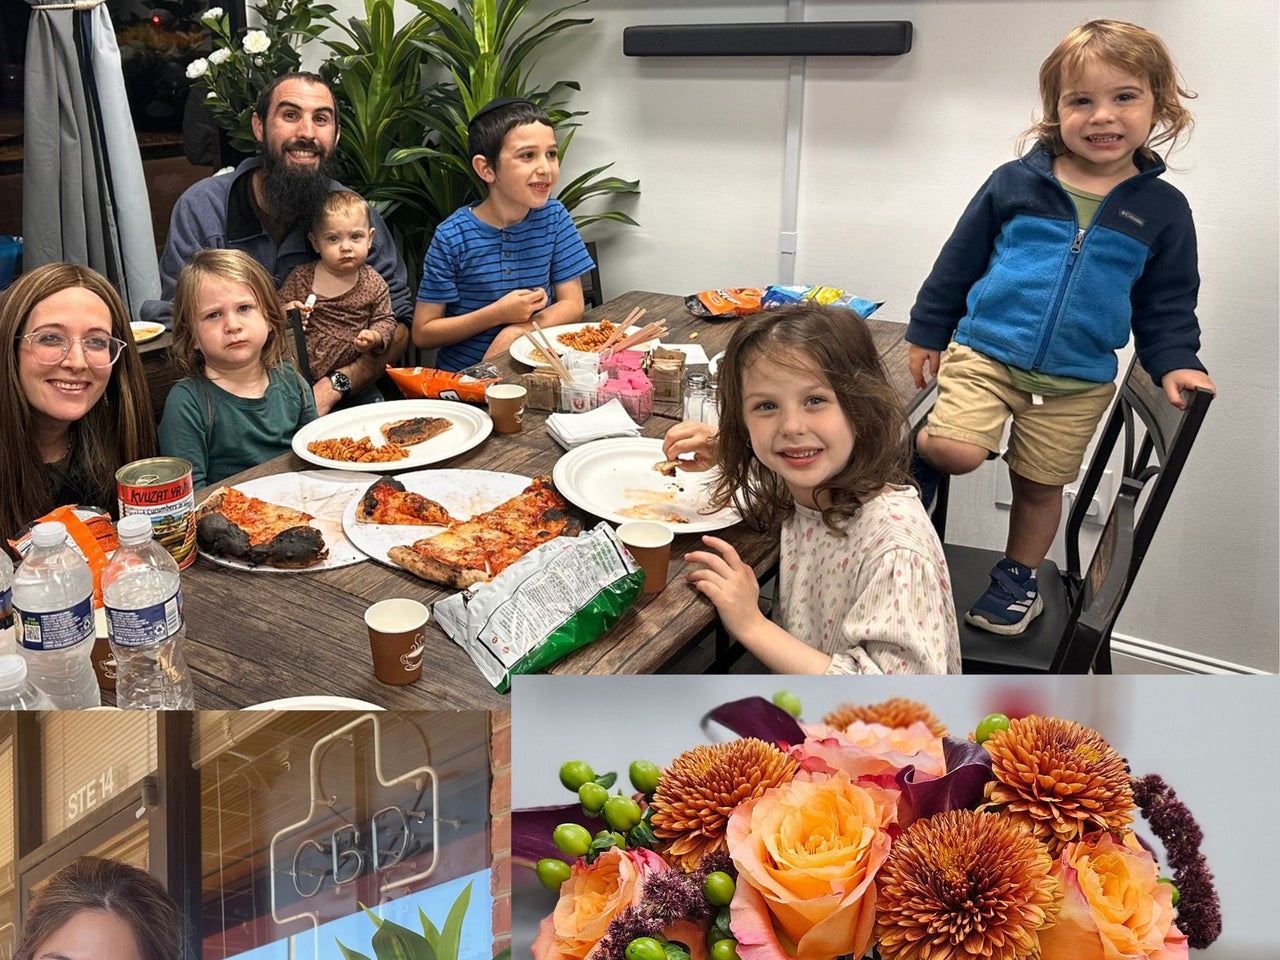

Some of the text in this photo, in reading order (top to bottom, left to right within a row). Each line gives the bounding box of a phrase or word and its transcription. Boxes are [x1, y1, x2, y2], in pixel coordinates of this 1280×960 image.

[131, 489, 168, 505] KVUZAT
[68, 766, 115, 820] STE 14
